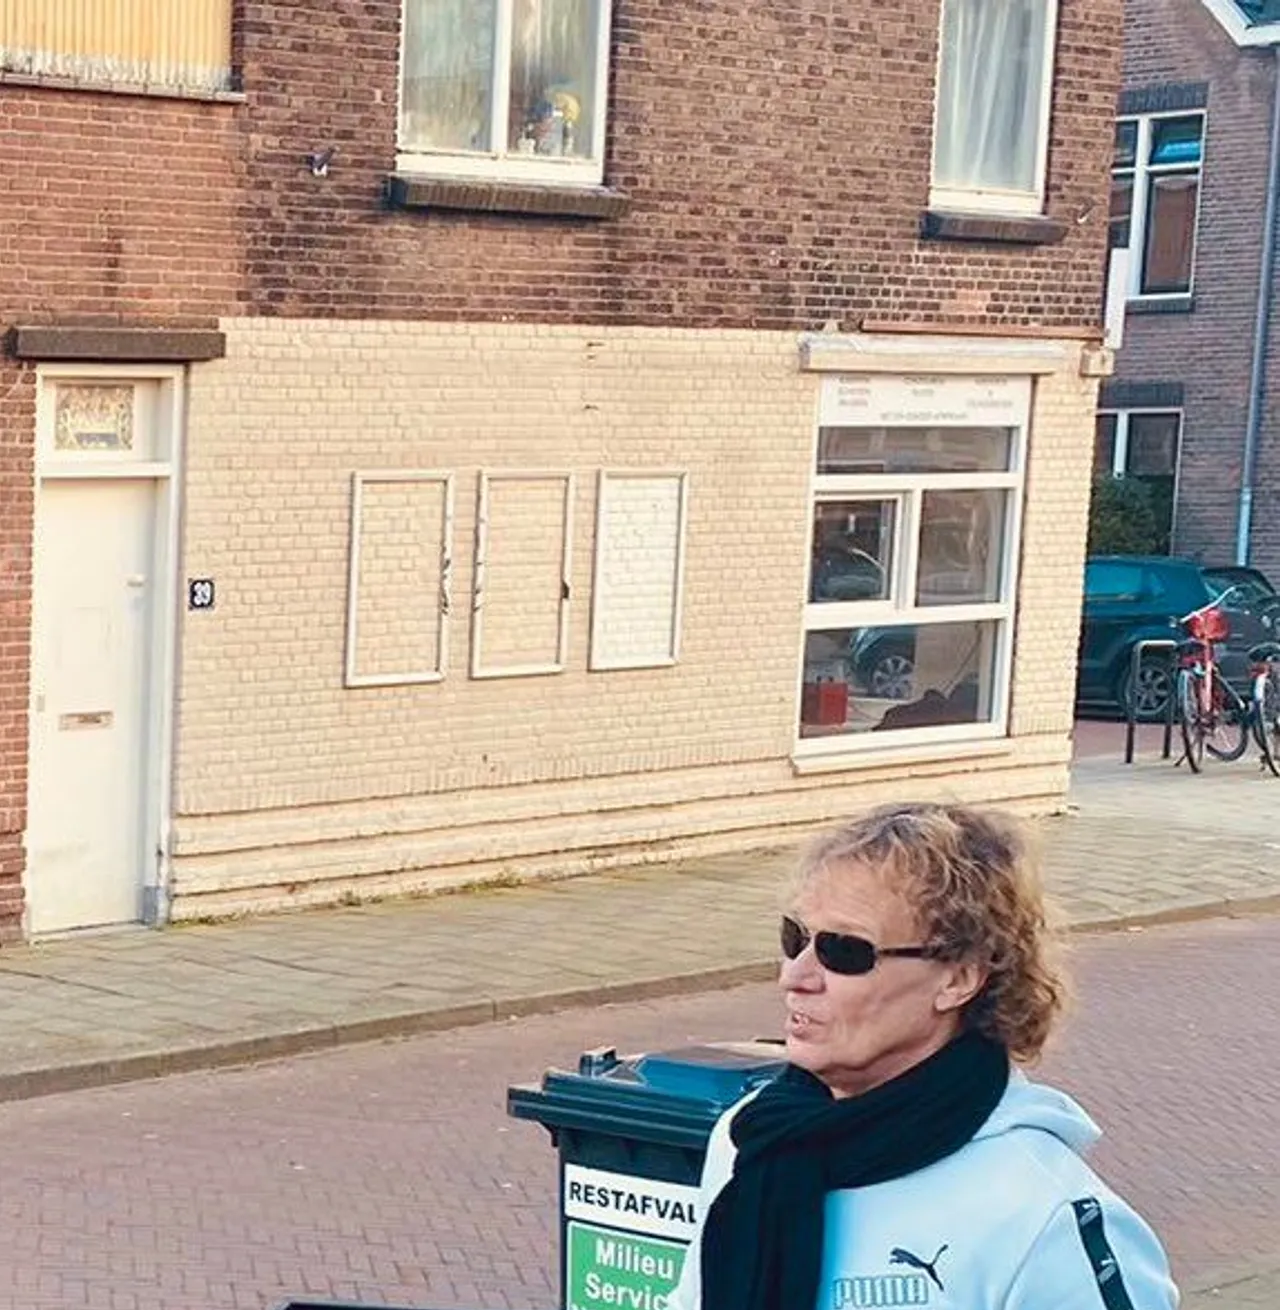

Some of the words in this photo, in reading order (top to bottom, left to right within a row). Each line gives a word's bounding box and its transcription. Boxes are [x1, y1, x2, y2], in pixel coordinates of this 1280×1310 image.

[569, 1181, 697, 1224] RESTAFVAL
[595, 1237, 674, 1280] Milieu
[833, 1274, 929, 1310] PUMA
